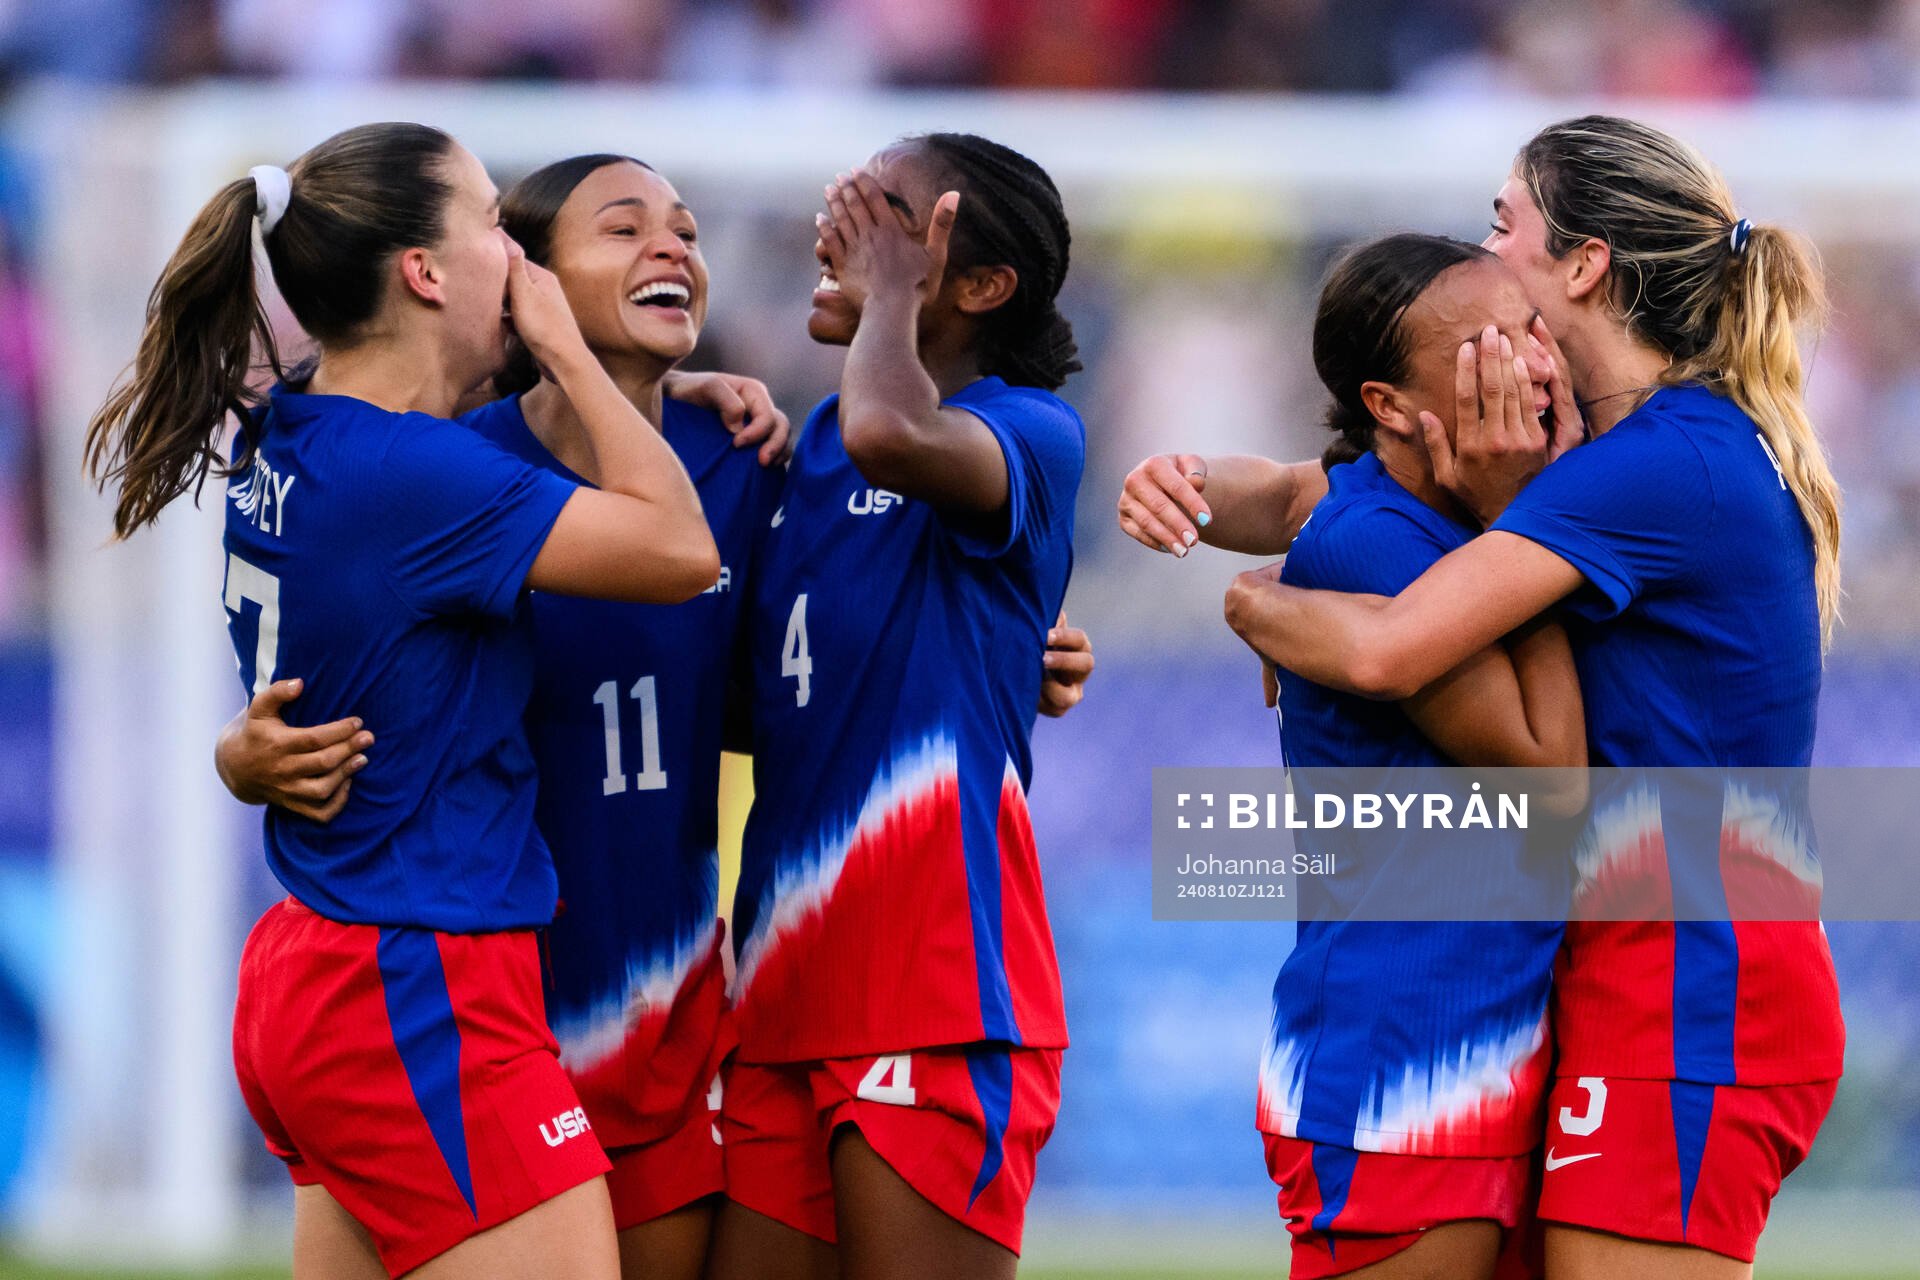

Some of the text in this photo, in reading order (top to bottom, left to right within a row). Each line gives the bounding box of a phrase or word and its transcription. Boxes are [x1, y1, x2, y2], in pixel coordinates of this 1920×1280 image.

[781, 593, 813, 707] 4
[593, 675, 667, 796] 11
[857, 1054, 916, 1106] 4
[538, 1106, 591, 1147] USA
